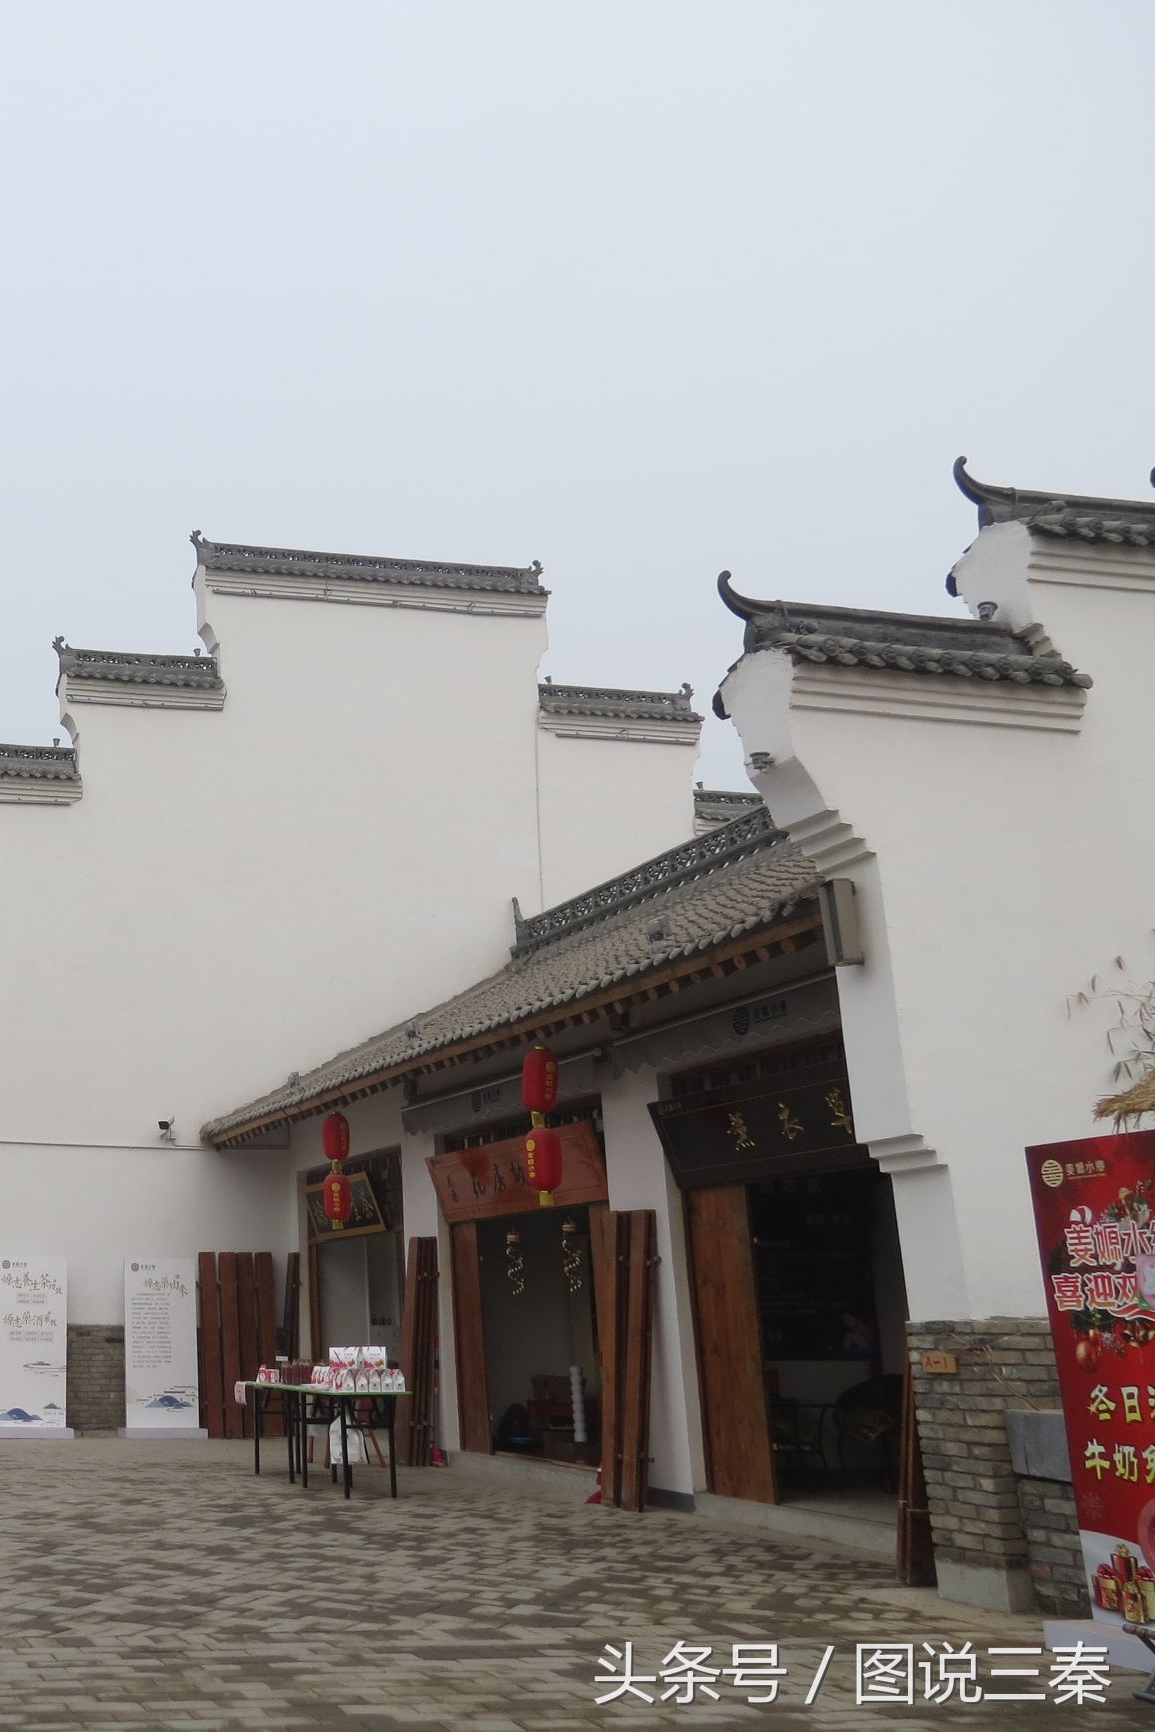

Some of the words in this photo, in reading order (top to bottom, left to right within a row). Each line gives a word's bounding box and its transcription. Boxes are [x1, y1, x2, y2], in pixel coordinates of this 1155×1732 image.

[1064, 1220, 1155, 1267] 姜嫄水
[926, 1356, 948, 1368] A-1
